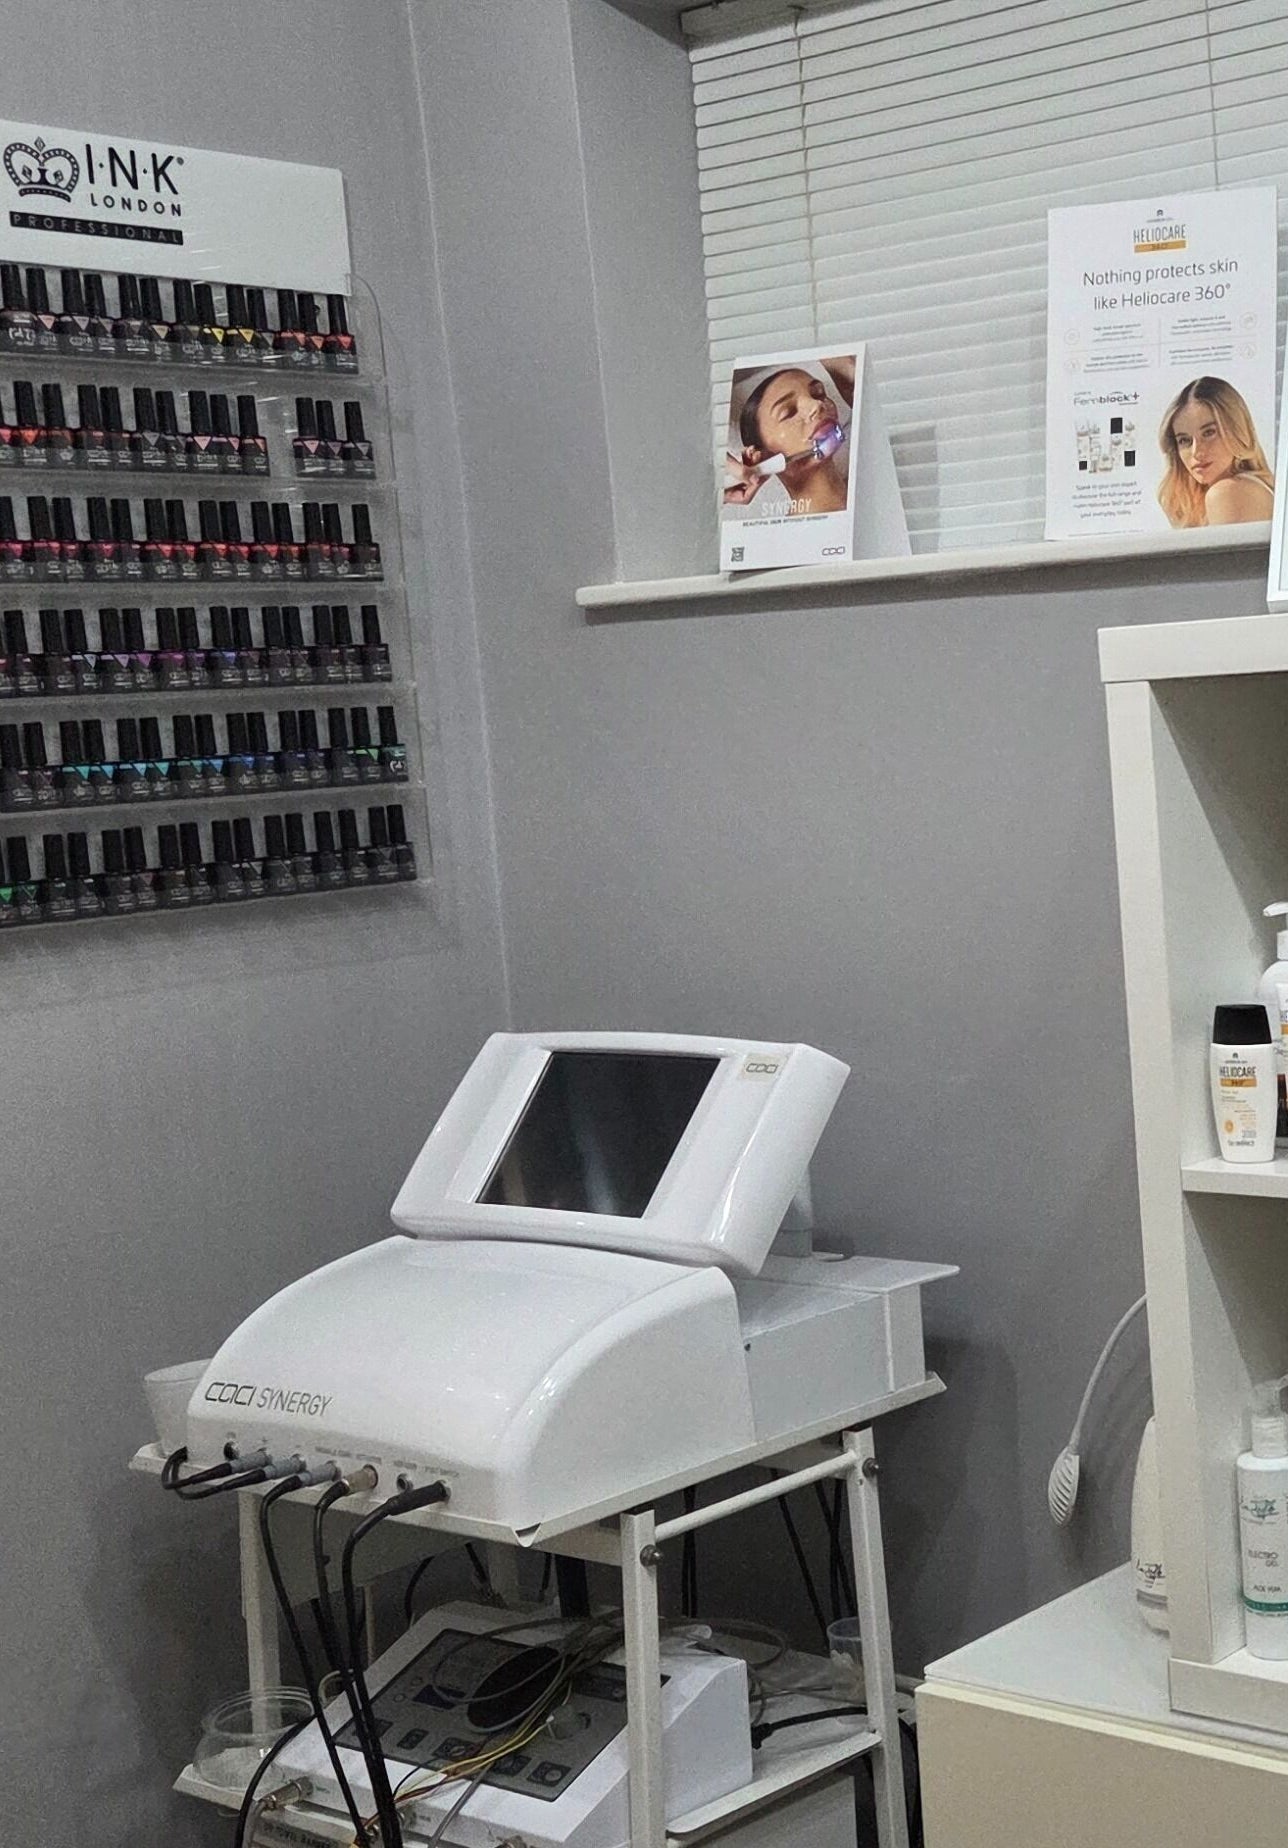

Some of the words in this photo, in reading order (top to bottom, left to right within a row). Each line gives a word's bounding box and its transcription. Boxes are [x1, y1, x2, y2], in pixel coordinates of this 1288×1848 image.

[90, 193, 182, 217] LONDON
[12, 213, 181, 244] PROFESSIONAL
[1133, 224, 1186, 243] HELIOCARE
[1083, 267, 1142, 288] Nothing
[1146, 261, 1206, 285] protects
[1209, 257, 1239, 273] skin
[1093, 293, 1118, 311] like
[1122, 289, 1191, 309] Heliocare
[1195, 283, 1231, 301] 360°
[761, 498, 812, 517] SYNERGY
[257, 1386, 333, 1417] SYNERGY
